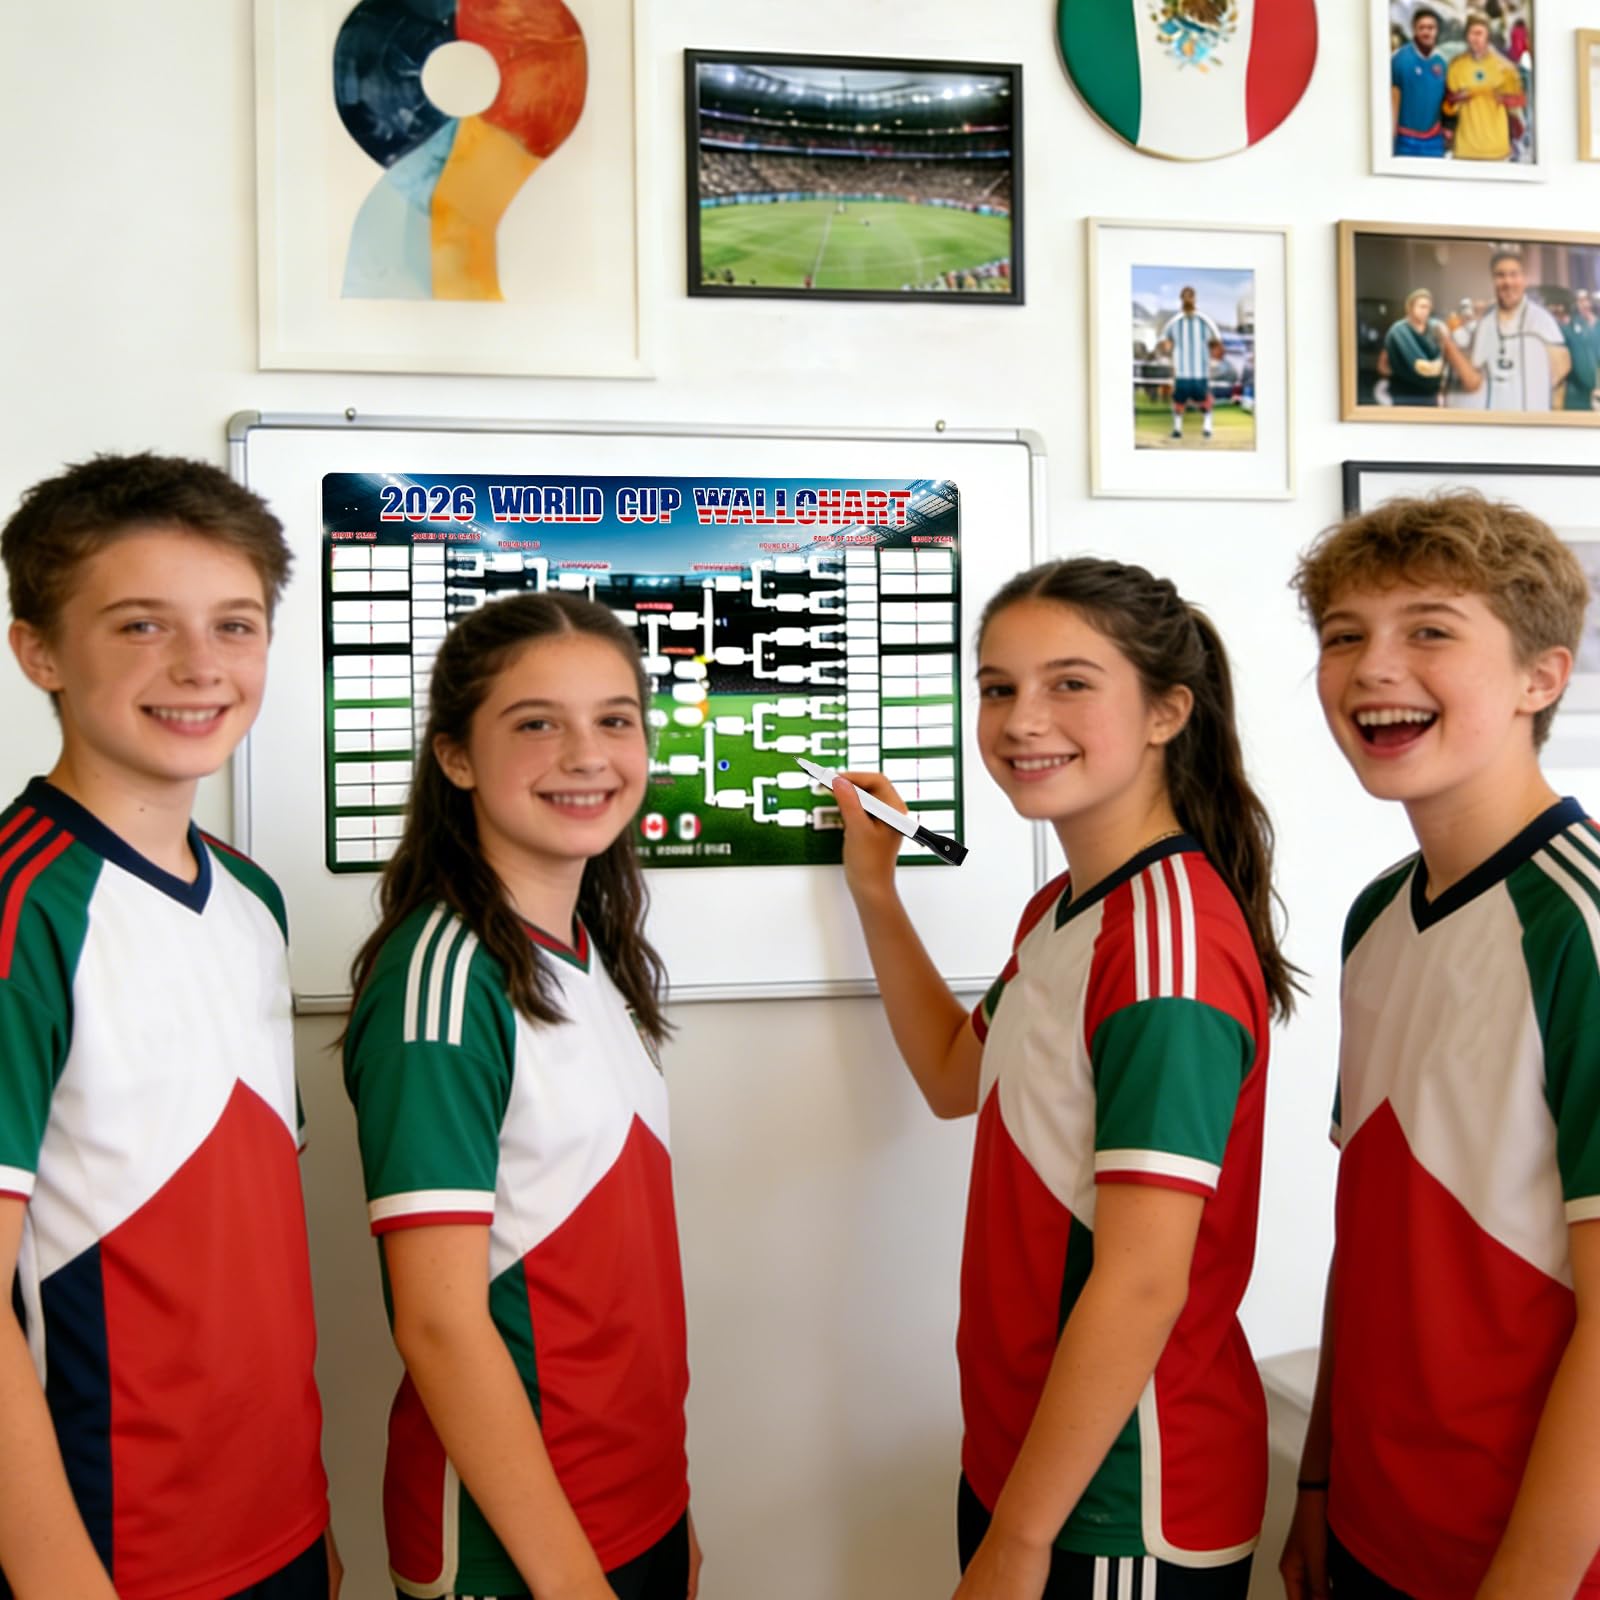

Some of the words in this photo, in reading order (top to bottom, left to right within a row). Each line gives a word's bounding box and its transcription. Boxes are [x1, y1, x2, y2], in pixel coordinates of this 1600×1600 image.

[380, 485, 476, 522] 2026
[489, 485, 604, 523] WORLD
[615, 487, 682, 524] CUP
[693, 488, 912, 526] WALLCHART
